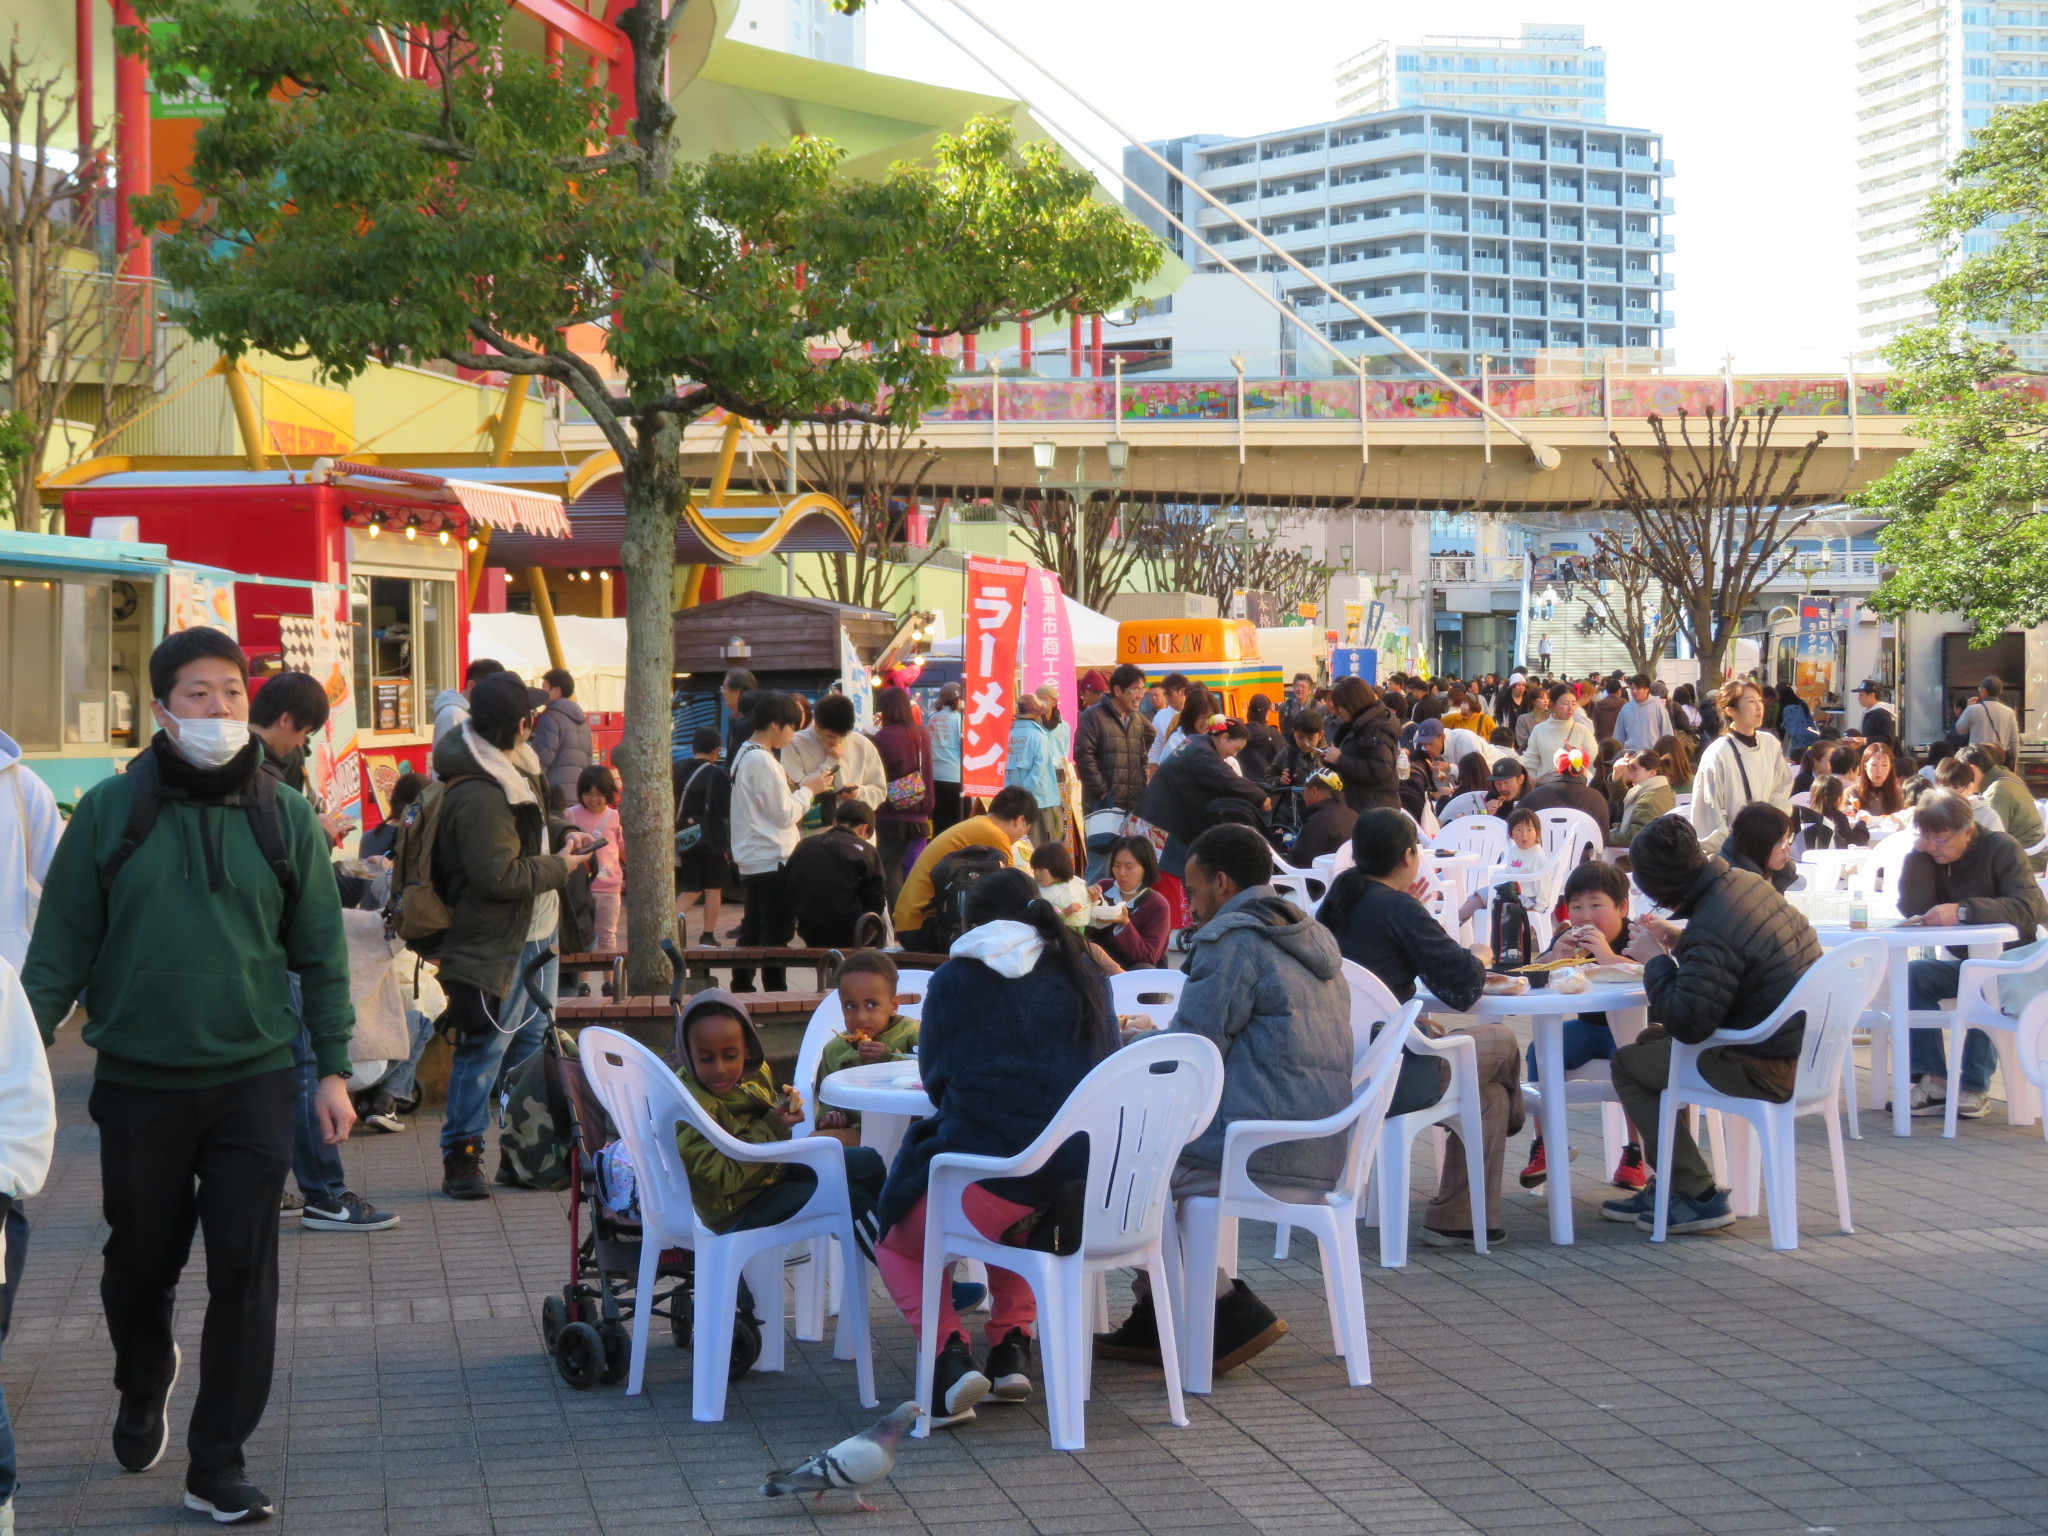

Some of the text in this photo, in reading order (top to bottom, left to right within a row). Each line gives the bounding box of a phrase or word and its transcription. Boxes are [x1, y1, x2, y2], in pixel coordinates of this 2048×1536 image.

[962, 586, 1013, 772] ラーメン
[1127, 633, 1213, 655] SAMUKAWA
